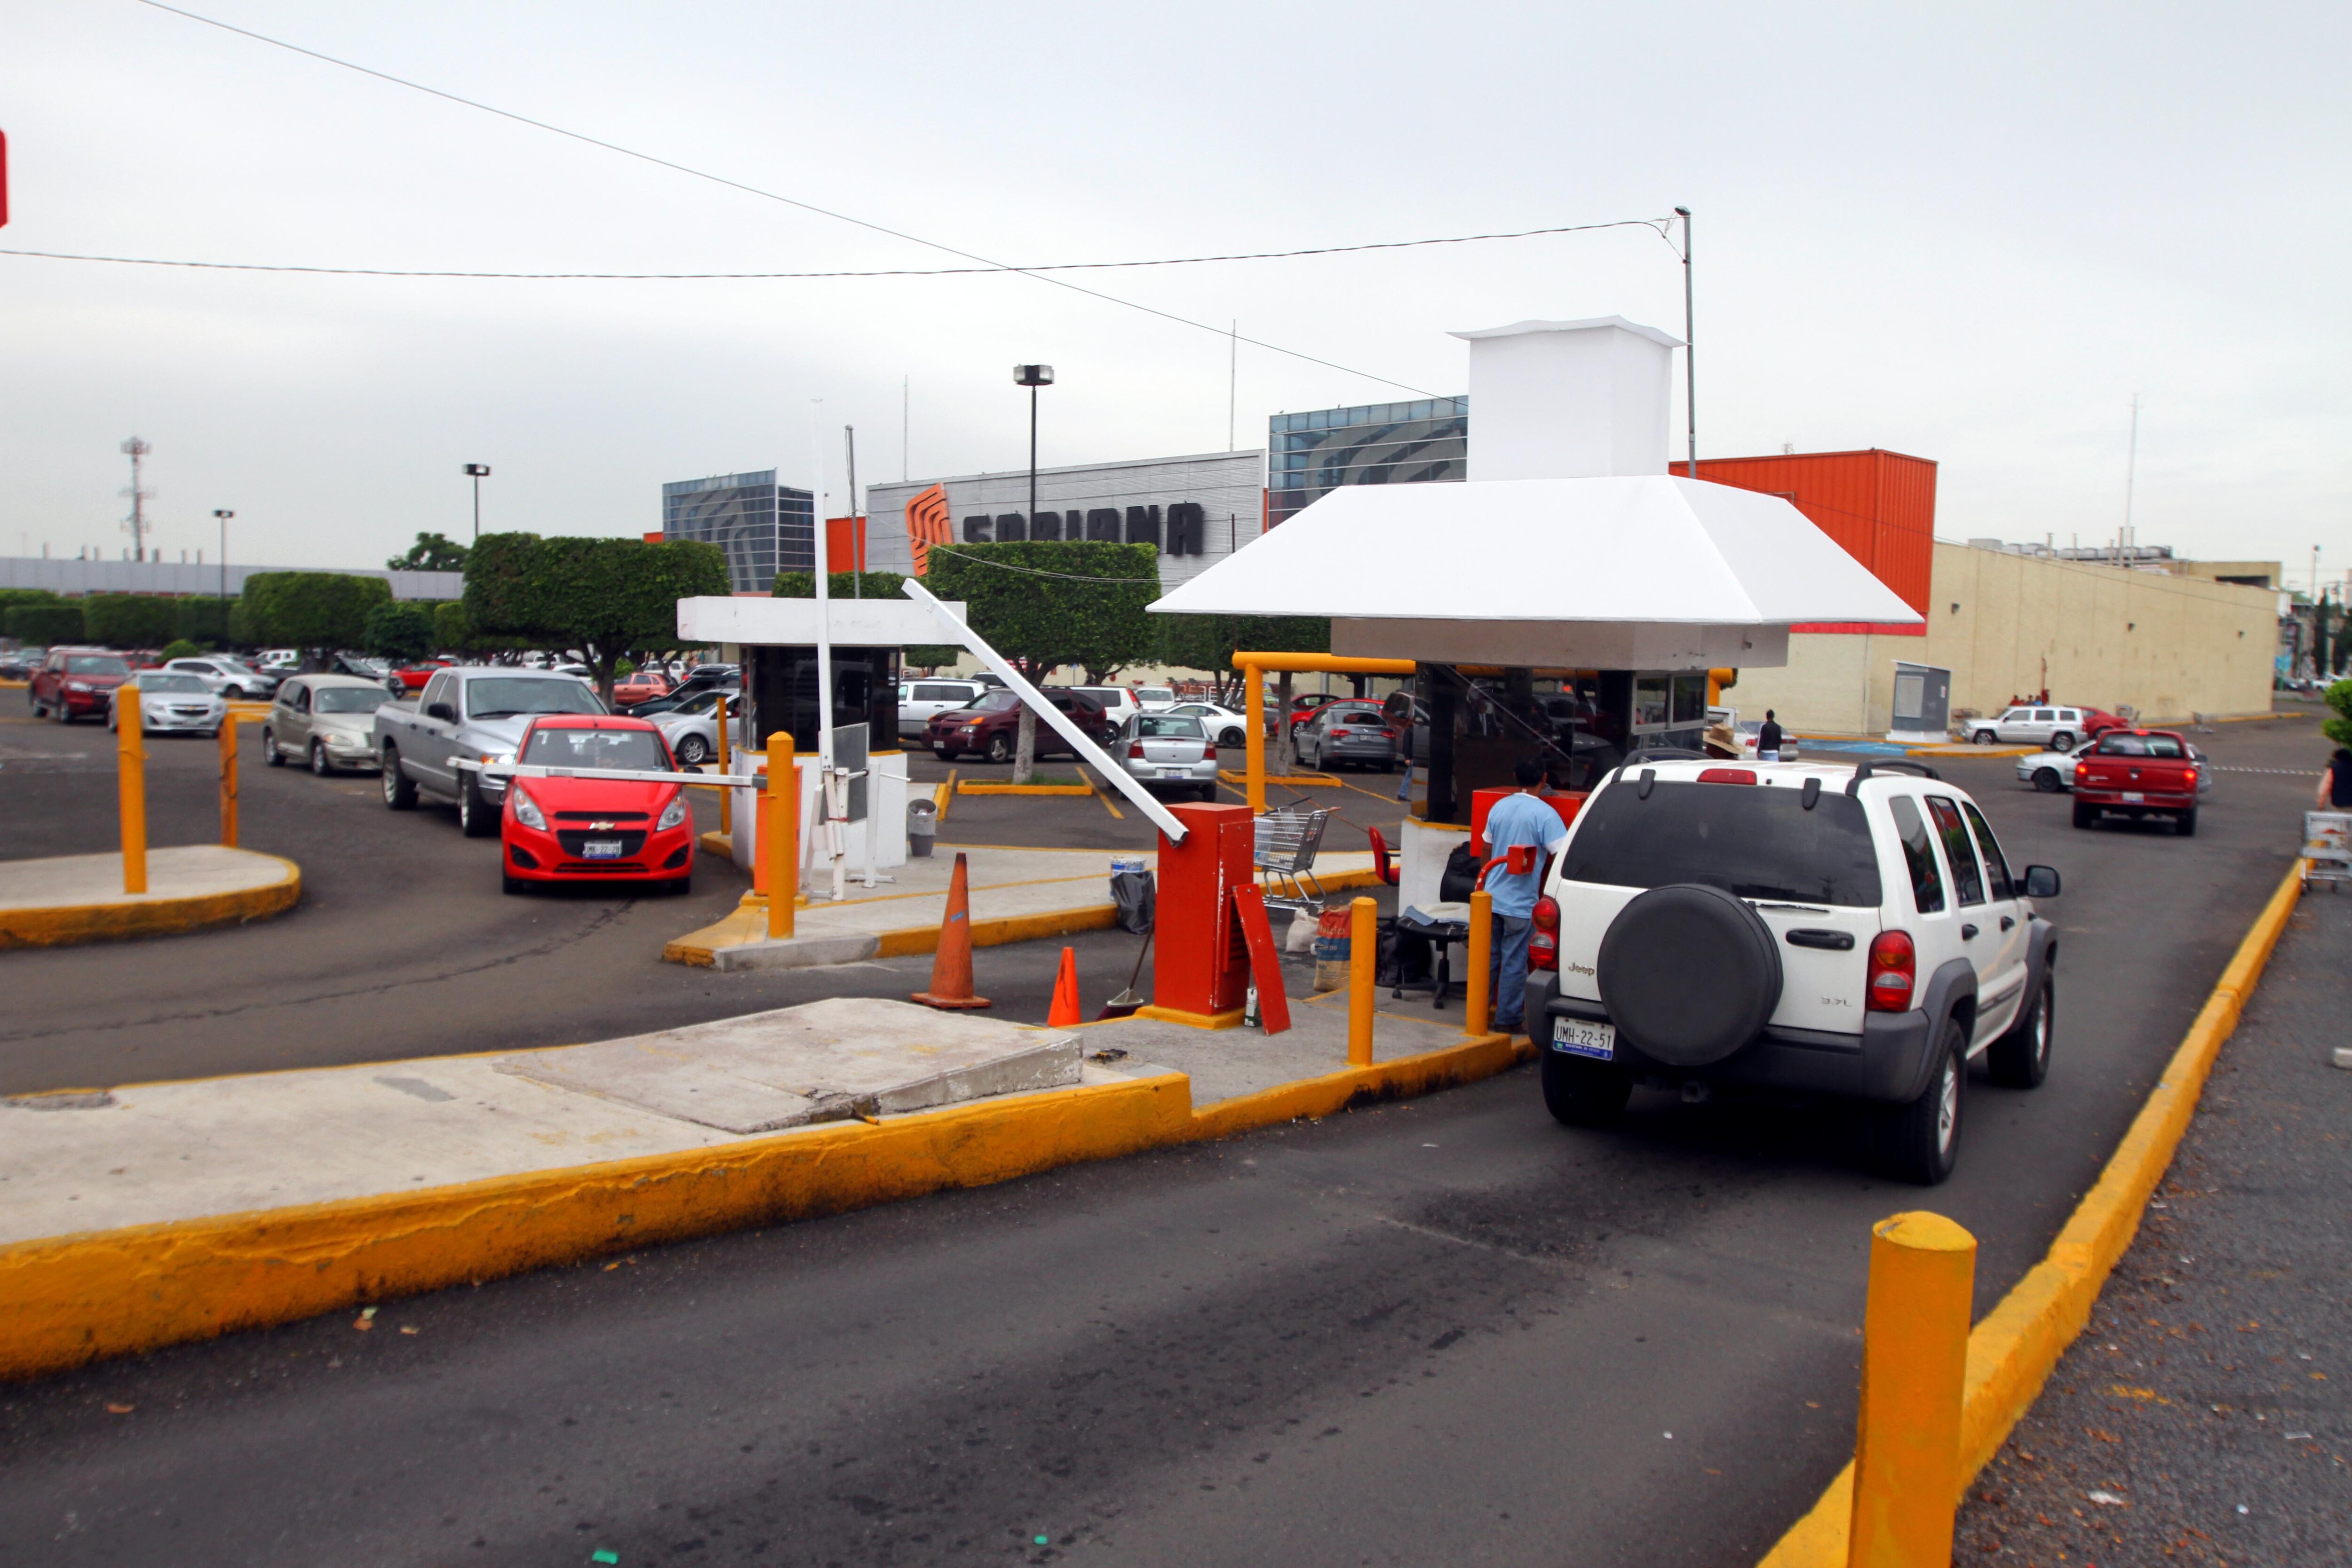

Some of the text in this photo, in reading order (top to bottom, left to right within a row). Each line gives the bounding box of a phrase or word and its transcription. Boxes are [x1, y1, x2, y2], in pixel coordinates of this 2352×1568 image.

[963, 502, 1203, 555] SORIANA
[1568, 962, 1595, 976] Jeep
[1821, 997, 1852, 1007] 3.7L
[1556, 1026, 1611, 1049] UMH-22-51
